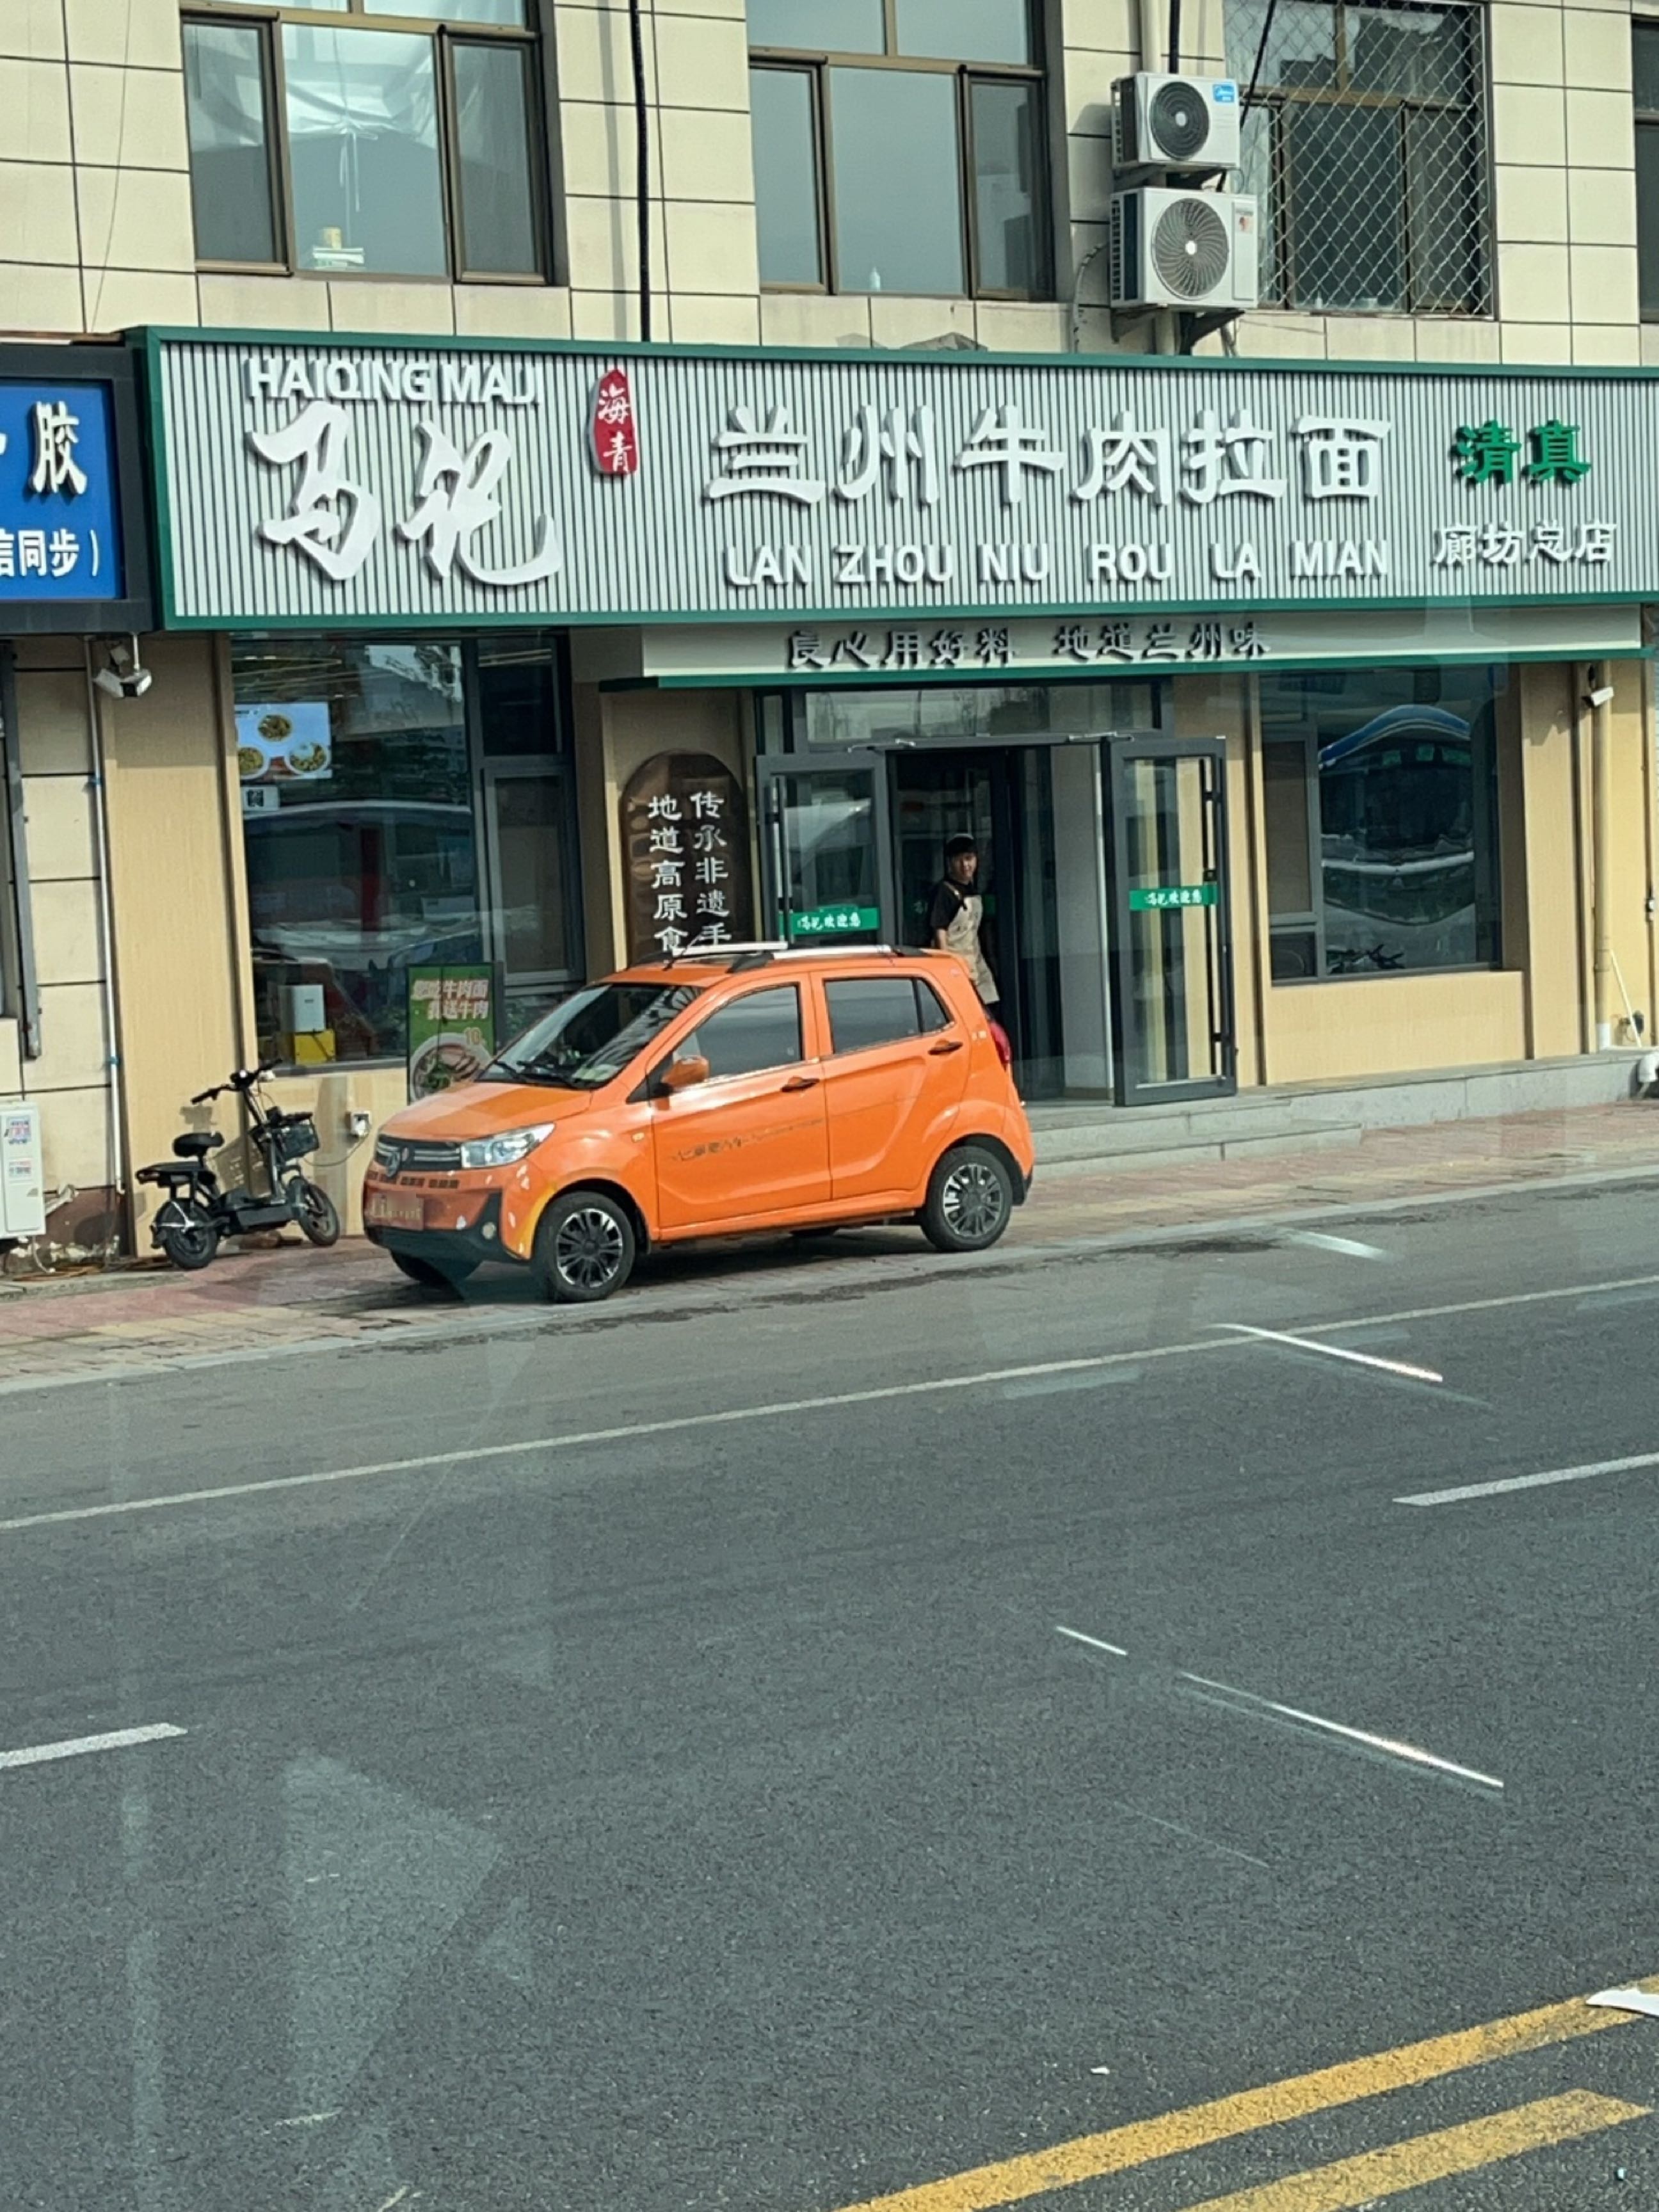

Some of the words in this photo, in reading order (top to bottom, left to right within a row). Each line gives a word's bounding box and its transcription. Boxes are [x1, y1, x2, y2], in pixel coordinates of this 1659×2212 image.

[598, 383, 630, 472] 海青
[704, 405, 1392, 506] 兰州牛肉拉面
[1455, 419, 1592, 485] 清真
[726, 545, 810, 585] LAN
[833, 544, 954, 584] ZHOU
[981, 544, 1049, 581] NIU
[1089, 543, 1173, 581] ROU
[1214, 543, 1262, 579] LA
[1292, 540, 1388, 577] MIAN
[1435, 520, 1617, 559] 廊坊总店
[790, 628, 1018, 668] 良心用好料
[1053, 622, 1270, 663] 地道兰州味
[690, 790, 732, 946] 传承非遗手
